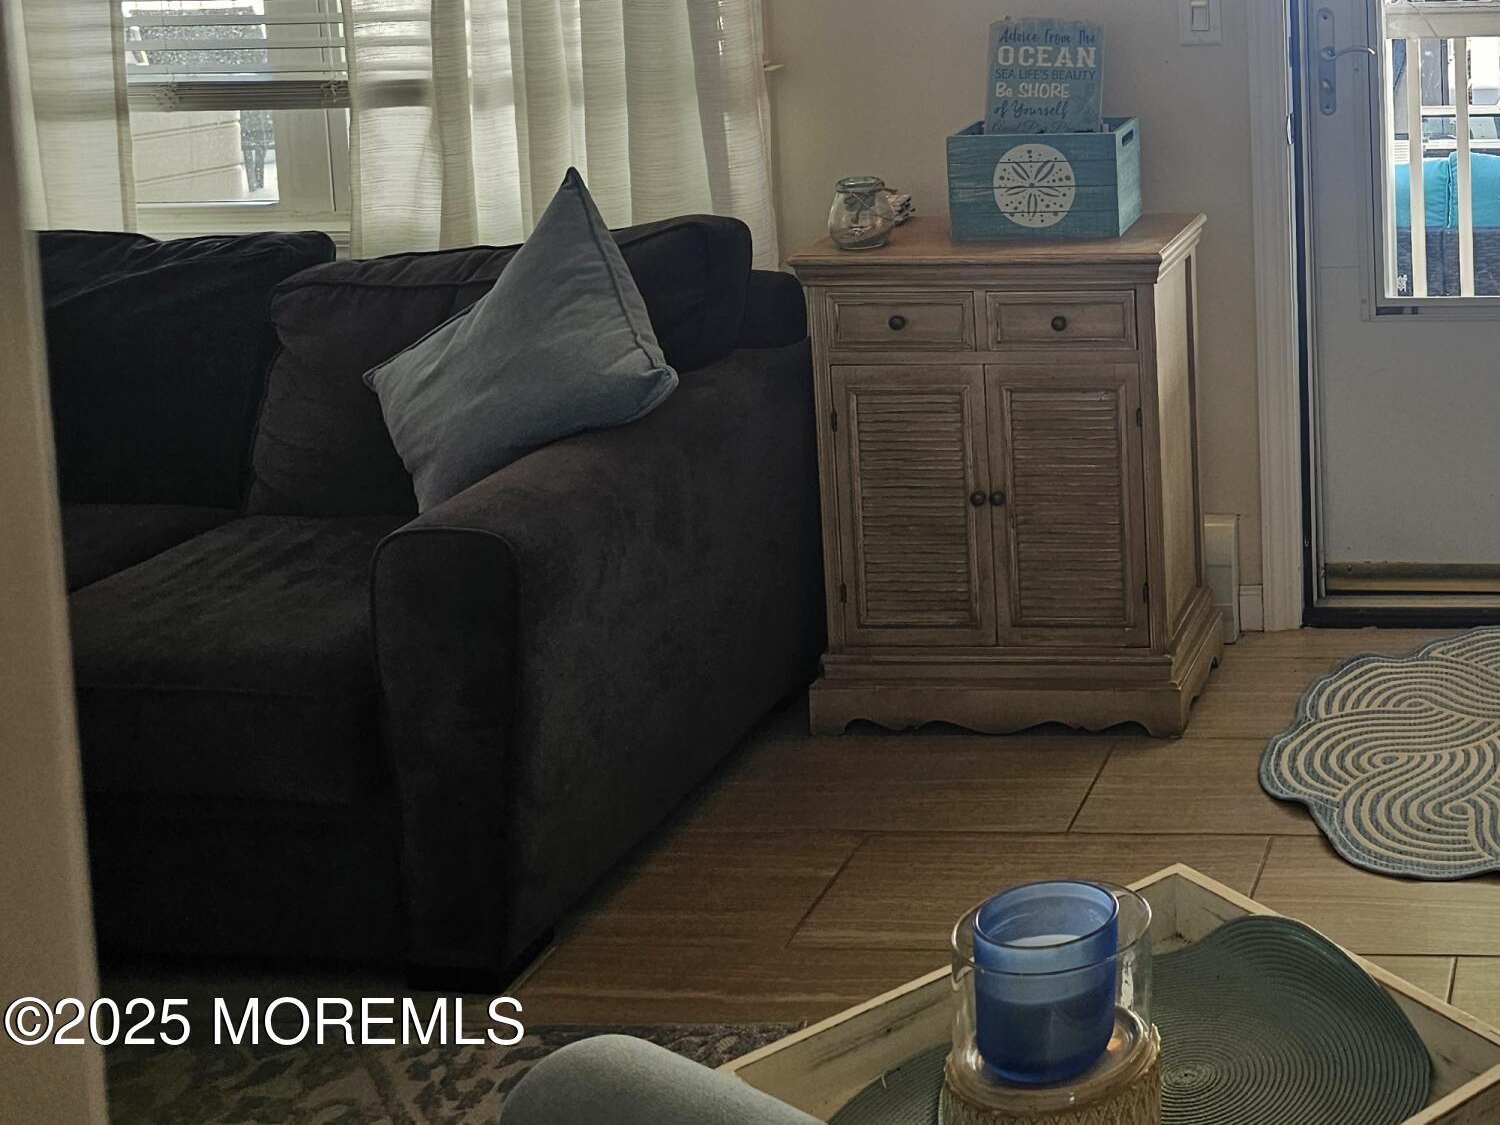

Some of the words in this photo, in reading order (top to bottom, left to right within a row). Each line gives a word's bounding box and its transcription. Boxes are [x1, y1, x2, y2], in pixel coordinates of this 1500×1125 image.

[997, 45, 1097, 68] OCEAN
[995, 68, 1016, 80] SEA
[1019, 68, 1049, 80] LIFE'S
[1052, 68, 1096, 80] BEAUTY
[995, 82, 1013, 98] Be
[1018, 82, 1071, 99] SHORE
[993, 100, 1009, 118] of
[1011, 100, 1070, 119] Yourself
